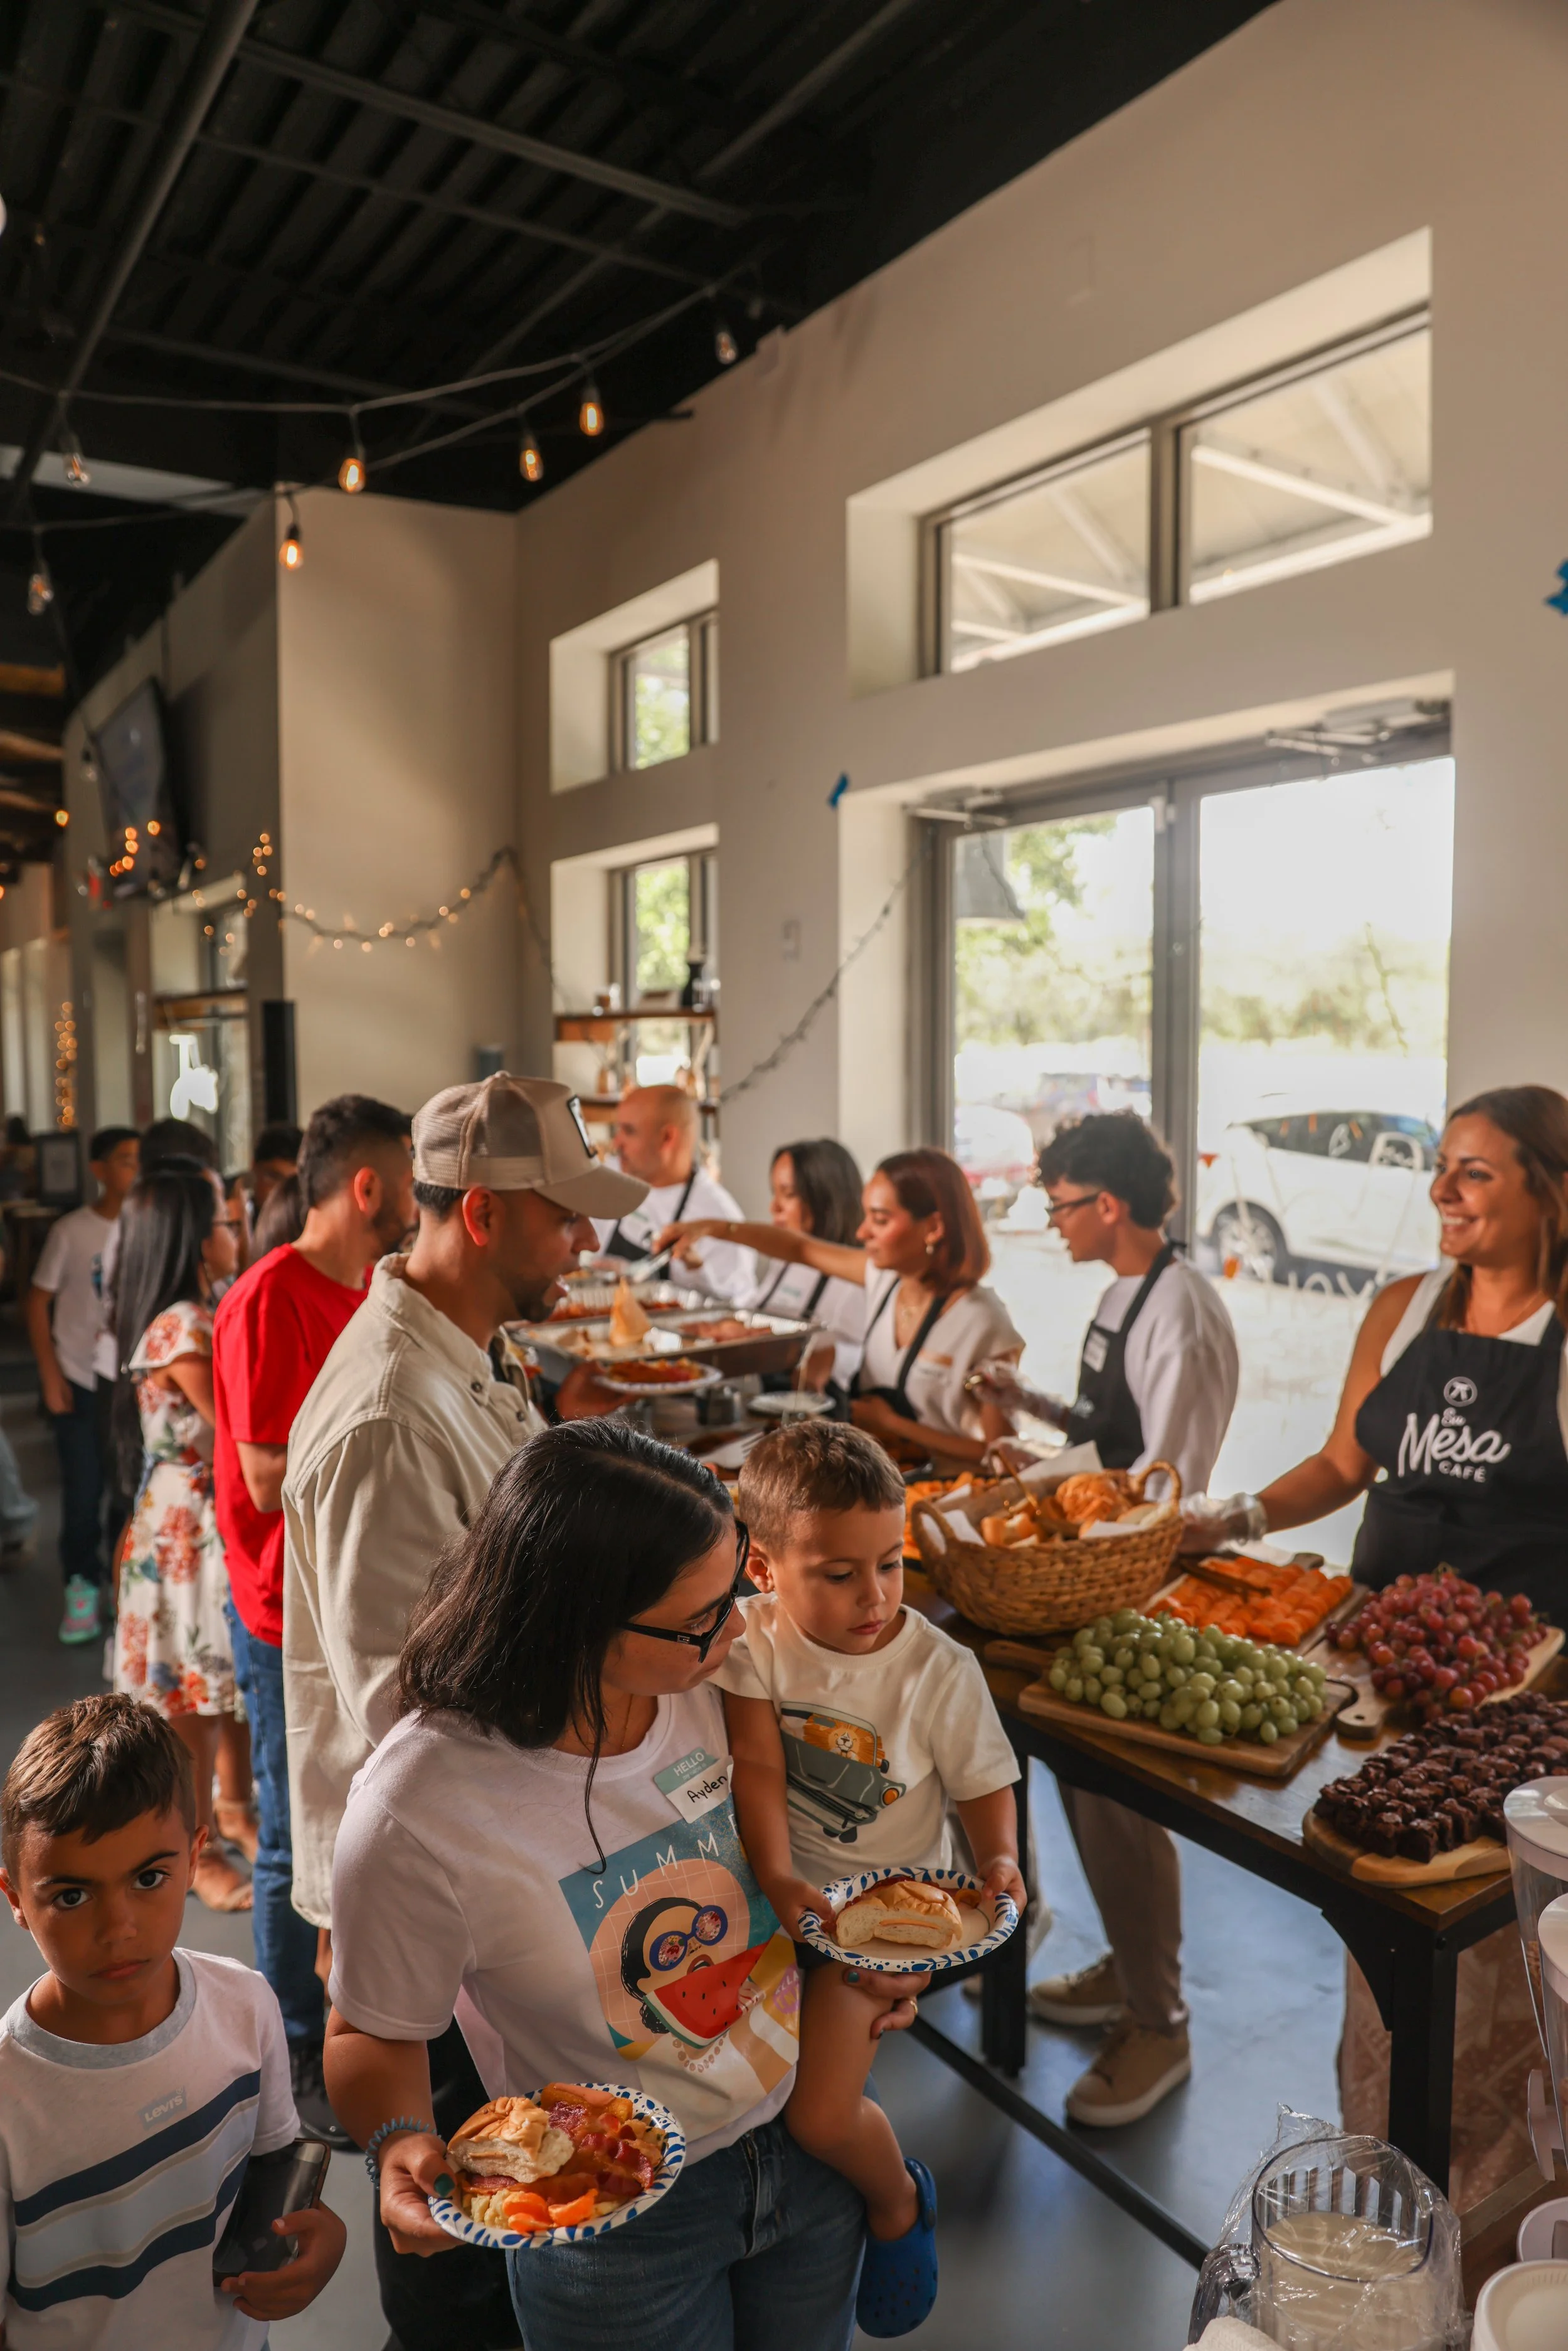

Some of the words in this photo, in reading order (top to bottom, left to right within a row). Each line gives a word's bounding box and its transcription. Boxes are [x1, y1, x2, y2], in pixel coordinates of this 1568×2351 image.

[1398, 1413, 1512, 1477] Mesa
[674, 1752, 704, 1776] HELLO
[687, 1776, 728, 1803] Ayden
